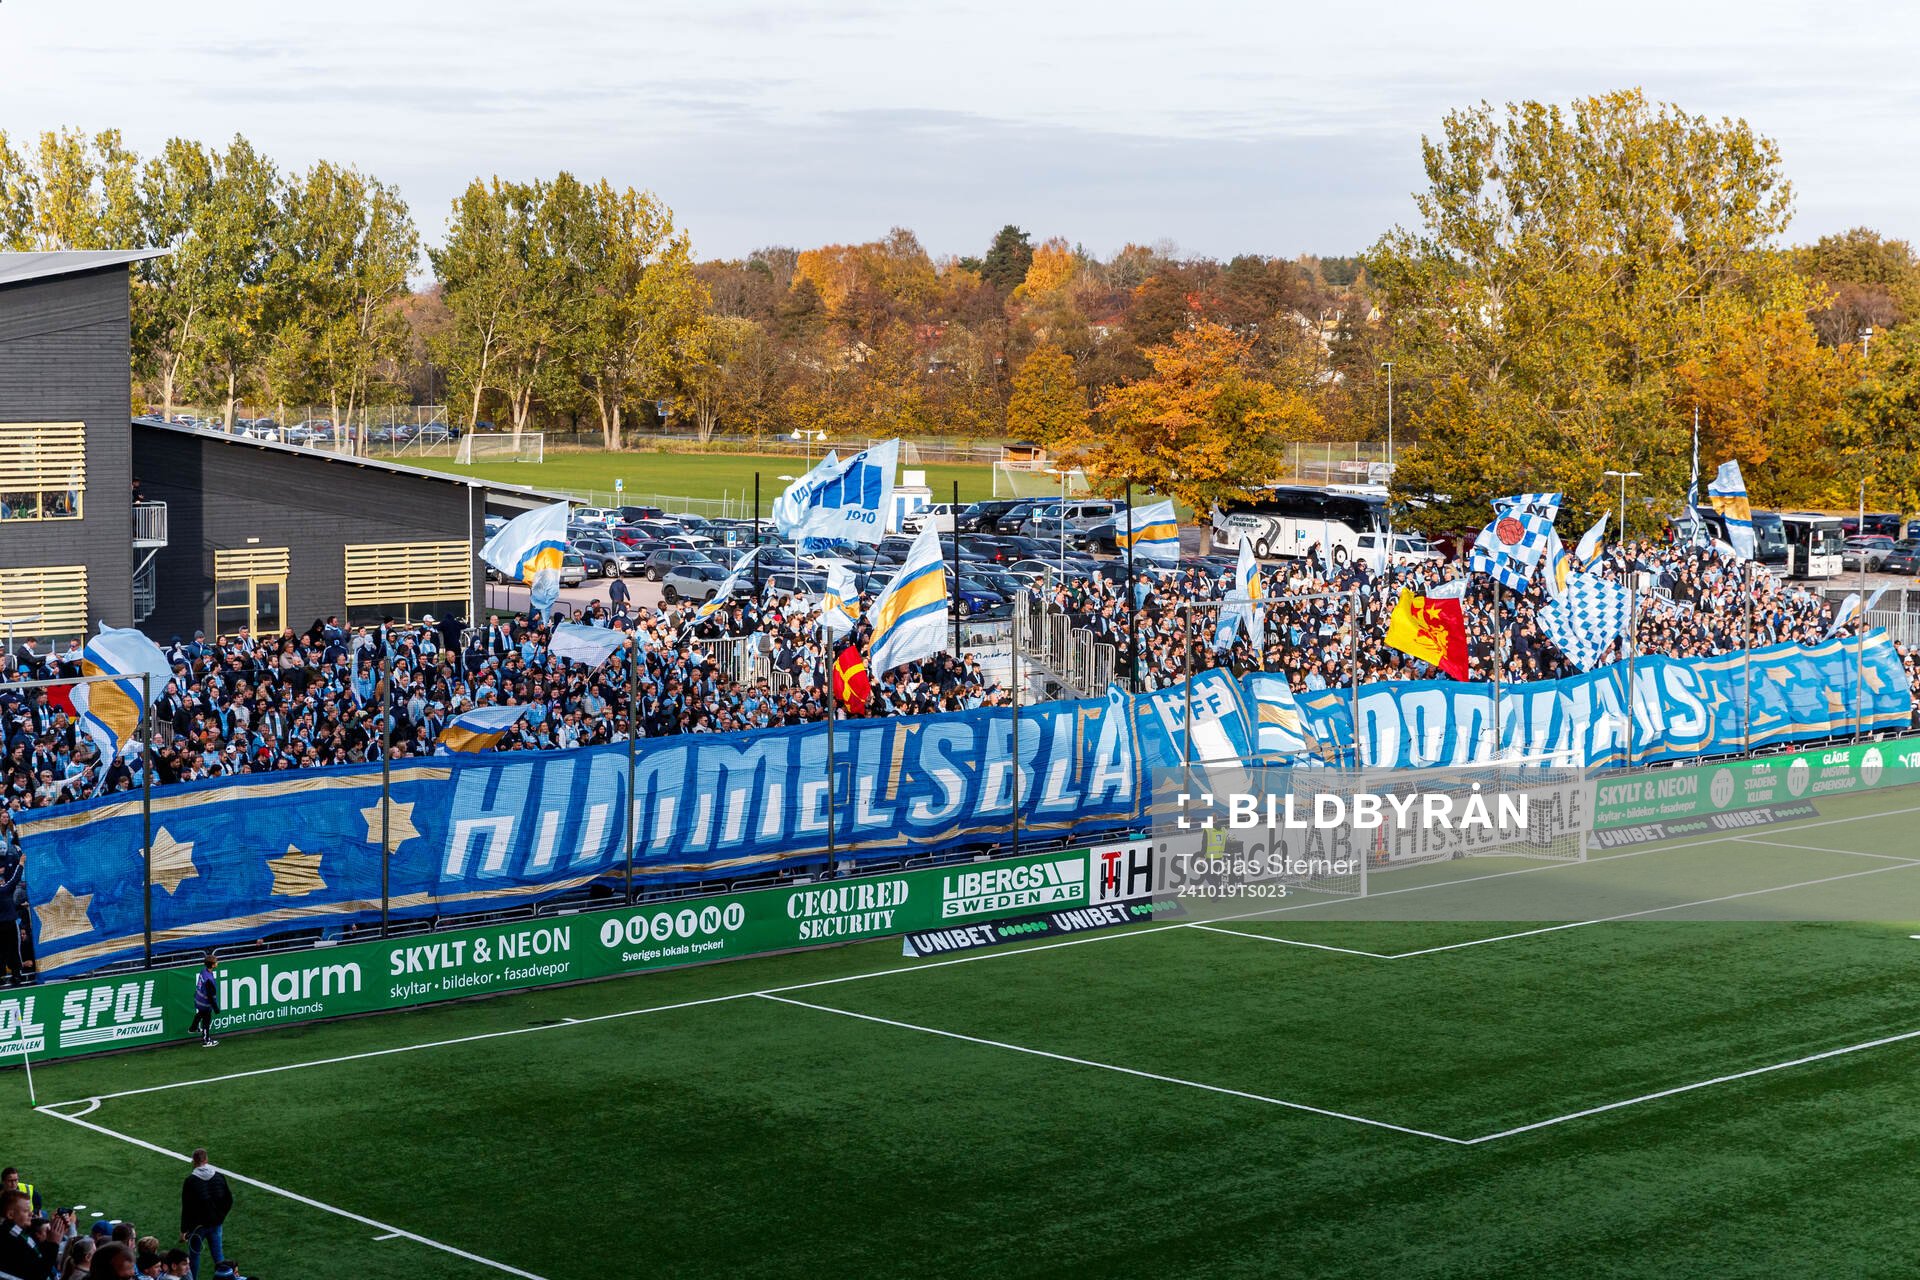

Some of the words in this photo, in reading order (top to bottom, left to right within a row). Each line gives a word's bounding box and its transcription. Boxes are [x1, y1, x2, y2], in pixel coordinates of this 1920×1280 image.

[845, 509, 876, 525] 1910
[1168, 692, 1223, 727] MFF
[440, 682, 1138, 883] HIMMELSBLÅ
[1598, 782, 1643, 806] SKYLT
[1643, 780, 1656, 800] &
[1657, 774, 1698, 799] NEON
[1626, 805, 1656, 819] bildekor
[1660, 800, 1697, 814] fasadvepor
[1711, 808, 1776, 830] UNIBET
[1600, 823, 1667, 847] UNIBET
[1127, 818, 1288, 896] Hissch
[943, 862, 1045, 900] LIBERGS
[787, 880, 909, 919] CEQURED
[946, 891, 1041, 916] SWEDEN
[1052, 885, 1081, 900] AB
[798, 910, 896, 940] SECURITY
[1052, 903, 1130, 931] UNIBET
[390, 940, 467, 976] SKYLT
[472, 937, 492, 964] &
[498, 926, 571, 961] NEON
[622, 948, 661, 962] Sveriges
[662, 945, 689, 957] lokala
[691, 938, 724, 954] tryckeri
[913, 924, 997, 953] UNIBET
[196, 962, 362, 1011] inlarm
[390, 981, 433, 1000] skyltar
[442, 972, 494, 990] bildekor
[504, 960, 571, 981] fasadvepor
[60, 980, 164, 1031] SPOL
[206, 1011, 247, 1032] ygghet
[248, 1008, 275, 1021] nära
[277, 1004, 288, 1017] till
[290, 1001, 324, 1015] hands
[116, 1022, 161, 1036] PATRULLEN
